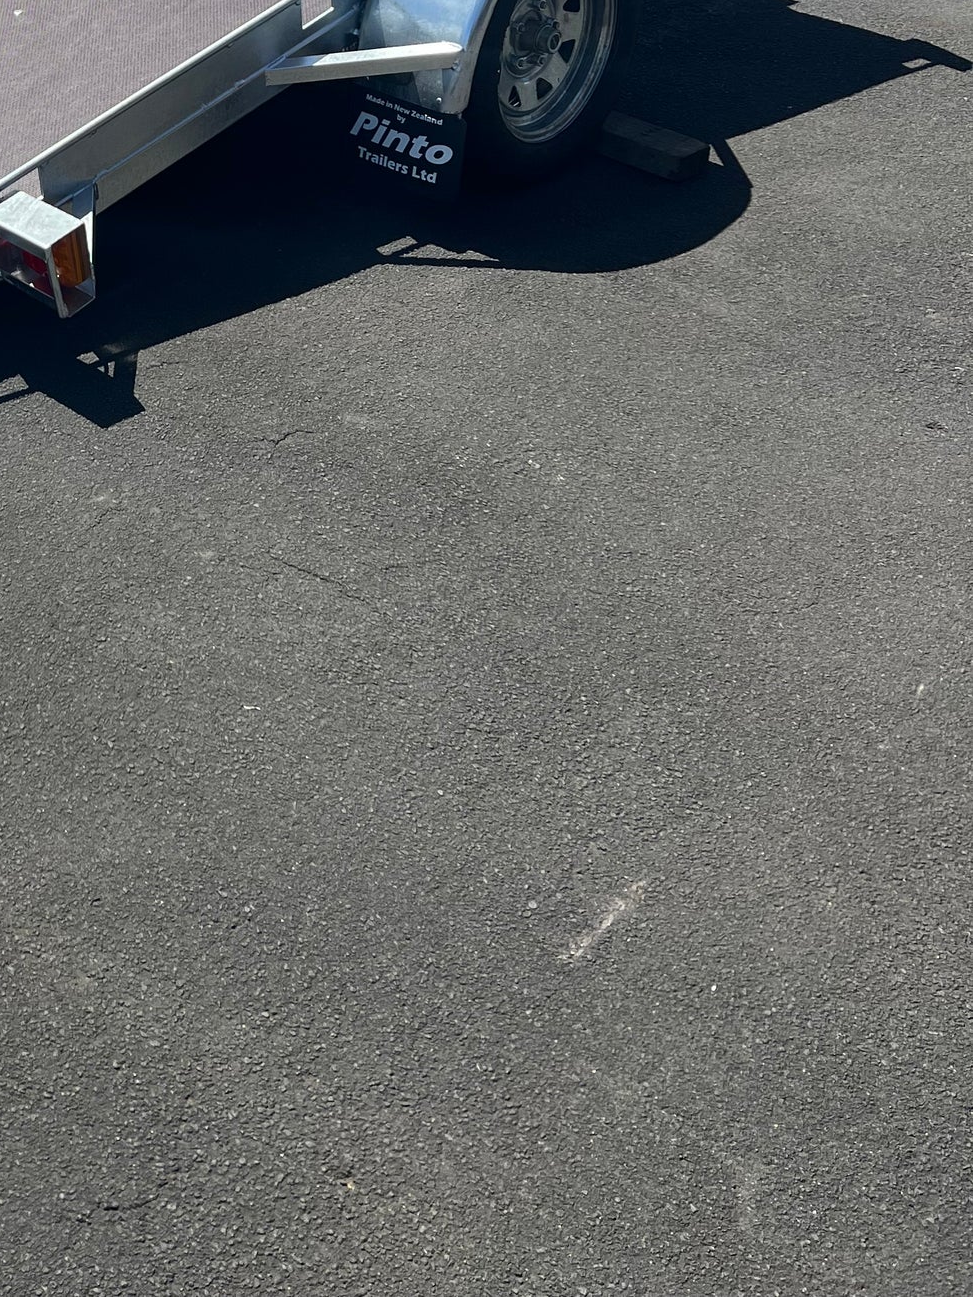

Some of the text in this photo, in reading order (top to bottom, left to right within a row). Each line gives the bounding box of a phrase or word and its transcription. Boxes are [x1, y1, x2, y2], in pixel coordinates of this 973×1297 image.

[366, 93, 443, 126] Made in New Zealand
[396, 114, 406, 124] by
[350, 111, 453, 165] Pinto
[357, 145, 438, 184] Trailers Ltd
